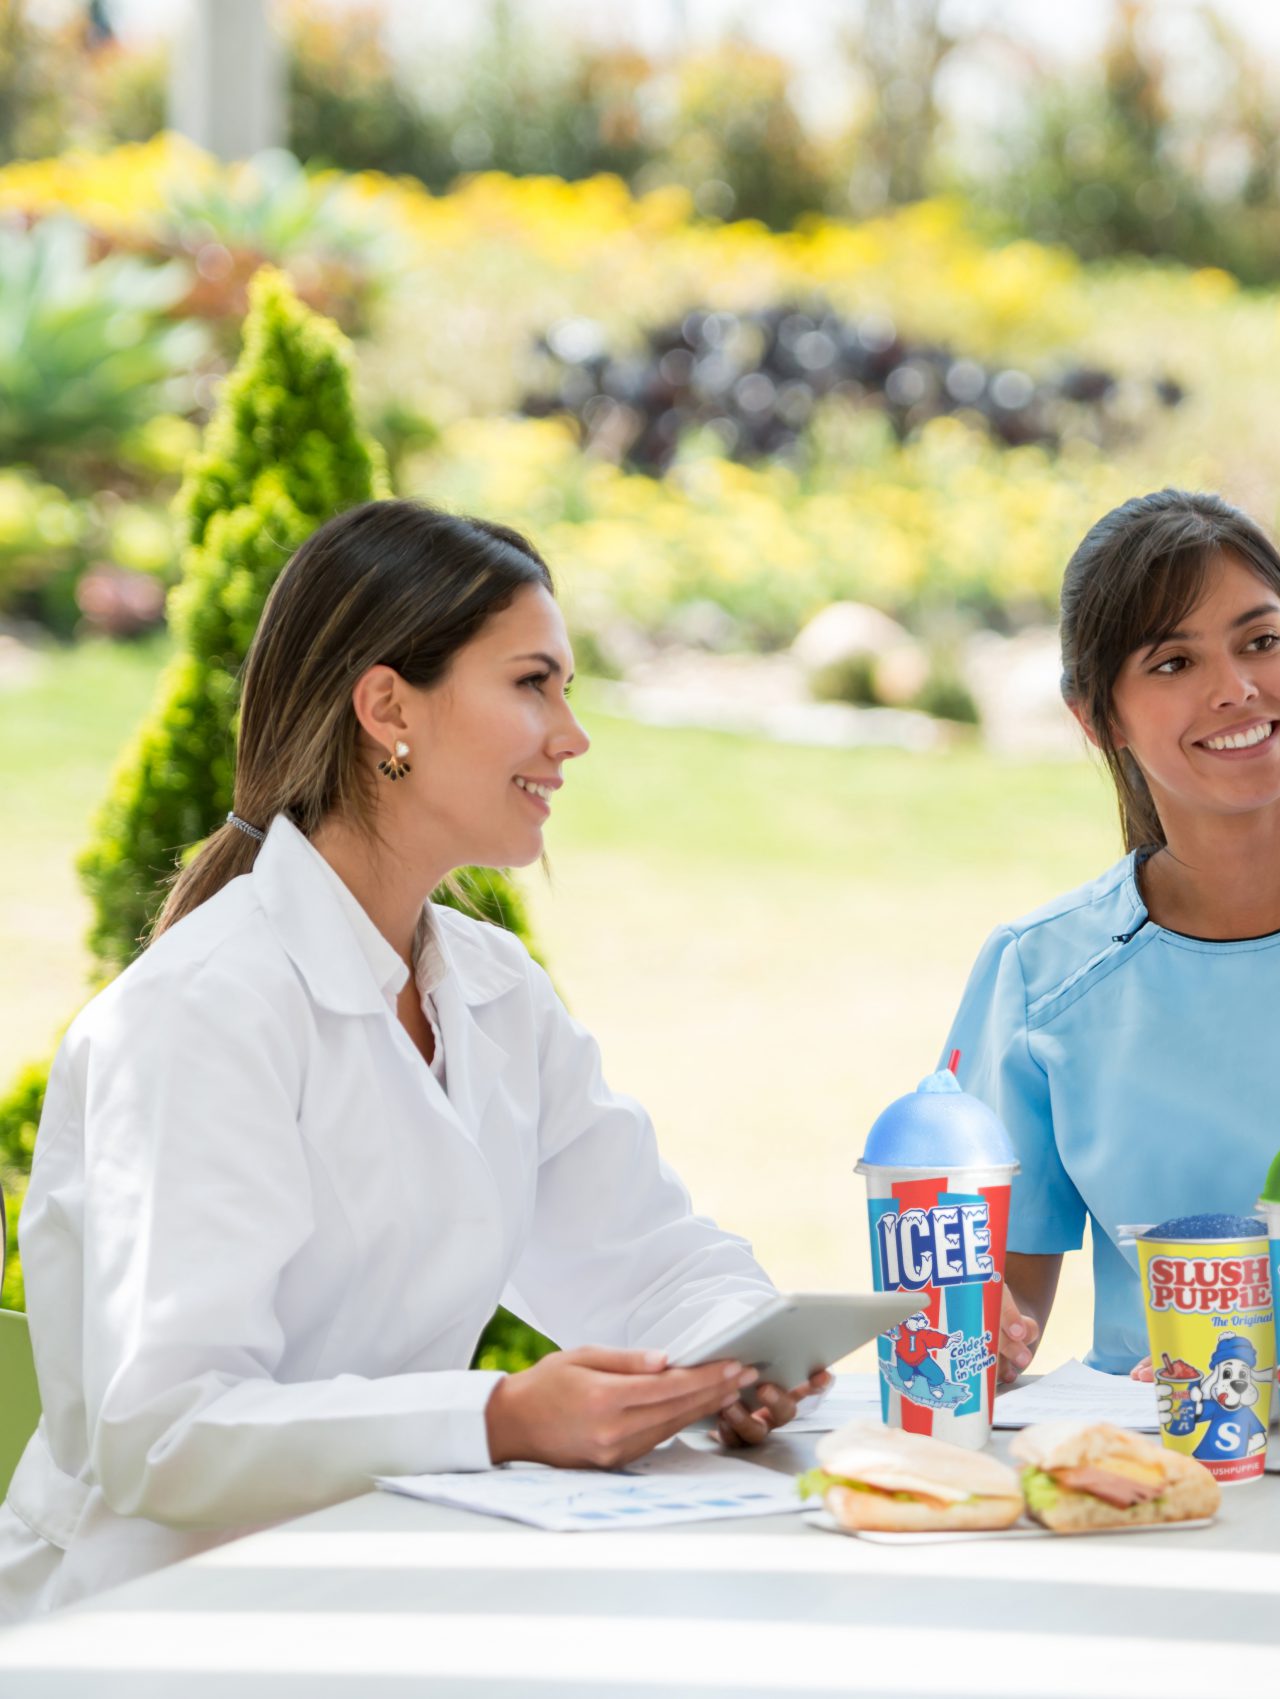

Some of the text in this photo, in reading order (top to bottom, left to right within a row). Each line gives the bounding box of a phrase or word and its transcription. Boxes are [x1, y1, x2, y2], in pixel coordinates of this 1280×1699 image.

[878, 1204, 993, 1290] ICEE
[1152, 1257, 1270, 1286] SLUSH
[1211, 1312, 1272, 1327] The Original
[950, 1332, 991, 1358] Coldest
[959, 1346, 987, 1369] Drink
[956, 1355, 995, 1380] in Town
[1215, 1422, 1241, 1451] S
